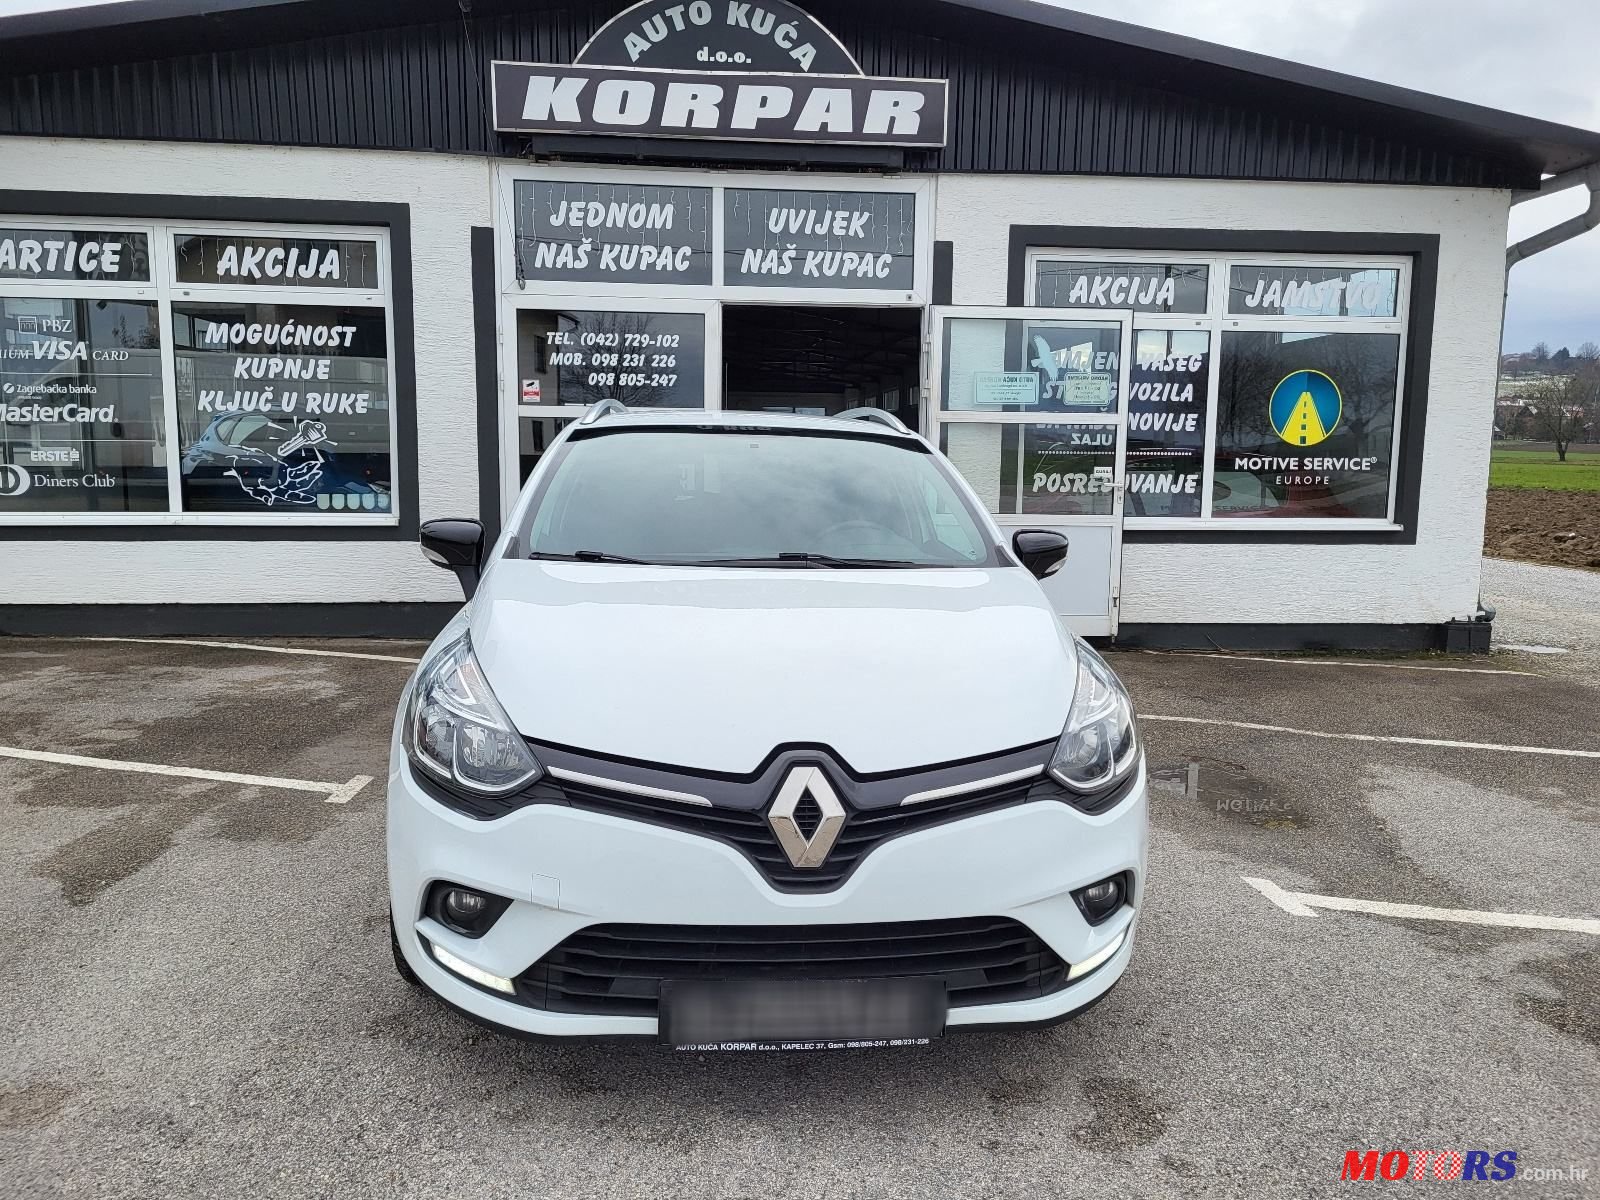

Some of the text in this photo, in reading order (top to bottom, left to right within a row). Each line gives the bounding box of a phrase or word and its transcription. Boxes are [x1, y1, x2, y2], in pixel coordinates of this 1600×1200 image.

[623, 0, 817, 73] AUTO KUĆA
[696, 46, 752, 64] d.o.o.
[521, 75, 926, 136] KORPAR
[549, 200, 674, 230] JEDNOM
[768, 207, 870, 239] UVIJEK
[0, 238, 122, 274] ARTICE
[216, 245, 340, 280] AKCIJA
[534, 237, 692, 272] NAŠ KUPAC
[740, 243, 893, 279] NAŠ KUPAC
[1068, 275, 1175, 306] AKCIJA
[1244, 279, 1383, 308] JAMSTVO
[42, 319, 73, 333] PBZ
[204, 319, 357, 347] MOGUĆNOST
[546, 331, 680, 348] TEL. (042) 729-102
[32, 340, 88, 361] VISA
[92, 350, 129, 361] CARD
[549, 352, 676, 368] MOB. 098 231 226
[233, 357, 331, 380] KUPNJE
[16, 383, 97, 396] Zagrebačka banka
[587, 372, 678, 388] 098 805-247
[198, 386, 370, 415] KLJUČ U RUKE
[1128, 382, 1193, 402] VOZILA
[1127, 412, 1199, 431] NOVIJE
[30, 451, 69, 462] ERSTE
[1234, 457, 1299, 470] MOTIVE
[33, 474, 79, 487] Diners
[1275, 475, 1330, 485] EUROPE
[720, 1042, 757, 1051] KORPAR
[781, 1042, 815, 1050] KAPELEC
